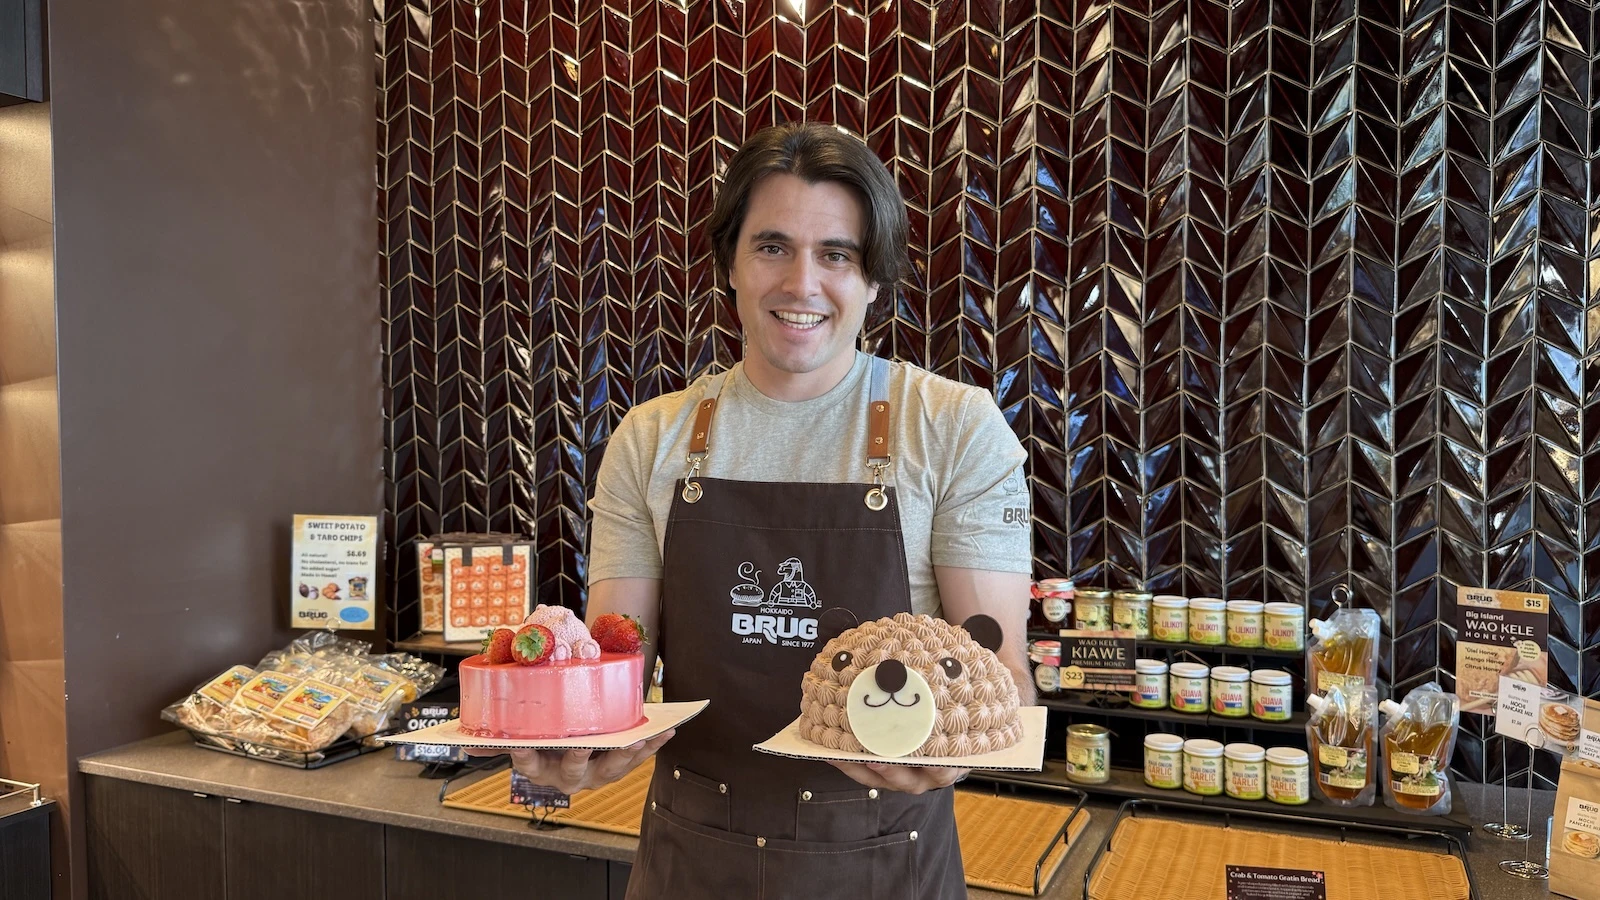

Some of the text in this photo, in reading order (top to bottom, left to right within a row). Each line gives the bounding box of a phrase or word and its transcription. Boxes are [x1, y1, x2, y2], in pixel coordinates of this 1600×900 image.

[1002, 508, 1029, 528] BRU
[1466, 594, 1492, 603] BRUG
[1526, 600, 1541, 608] $15
[299, 611, 328, 620] BRUG
[1466, 611, 1504, 621] Big Island
[732, 613, 818, 644] BRUG
[1466, 620, 1534, 636] WAO KELE
[1466, 631, 1505, 641] HONEY
[1072, 646, 1126, 660] KIAWE
[1066, 671, 1082, 680] $23
[1138, 685, 1159, 694] GUAVA
[1181, 689, 1202, 698] GUAVA
[1221, 693, 1242, 701] GUAVA
[1261, 697, 1282, 705] GUAVA
[421, 708, 448, 717] BRUG
[1502, 704, 1523, 714] PANCAKE
[407, 719, 451, 730] OKO
[418, 746, 448, 754] $16.00
[1190, 772, 1216, 781] GARLIC
[1232, 776, 1258, 786] GARLIC
[1271, 780, 1296, 791] GARLIC
[1569, 820, 1591, 828] PANCAKE
